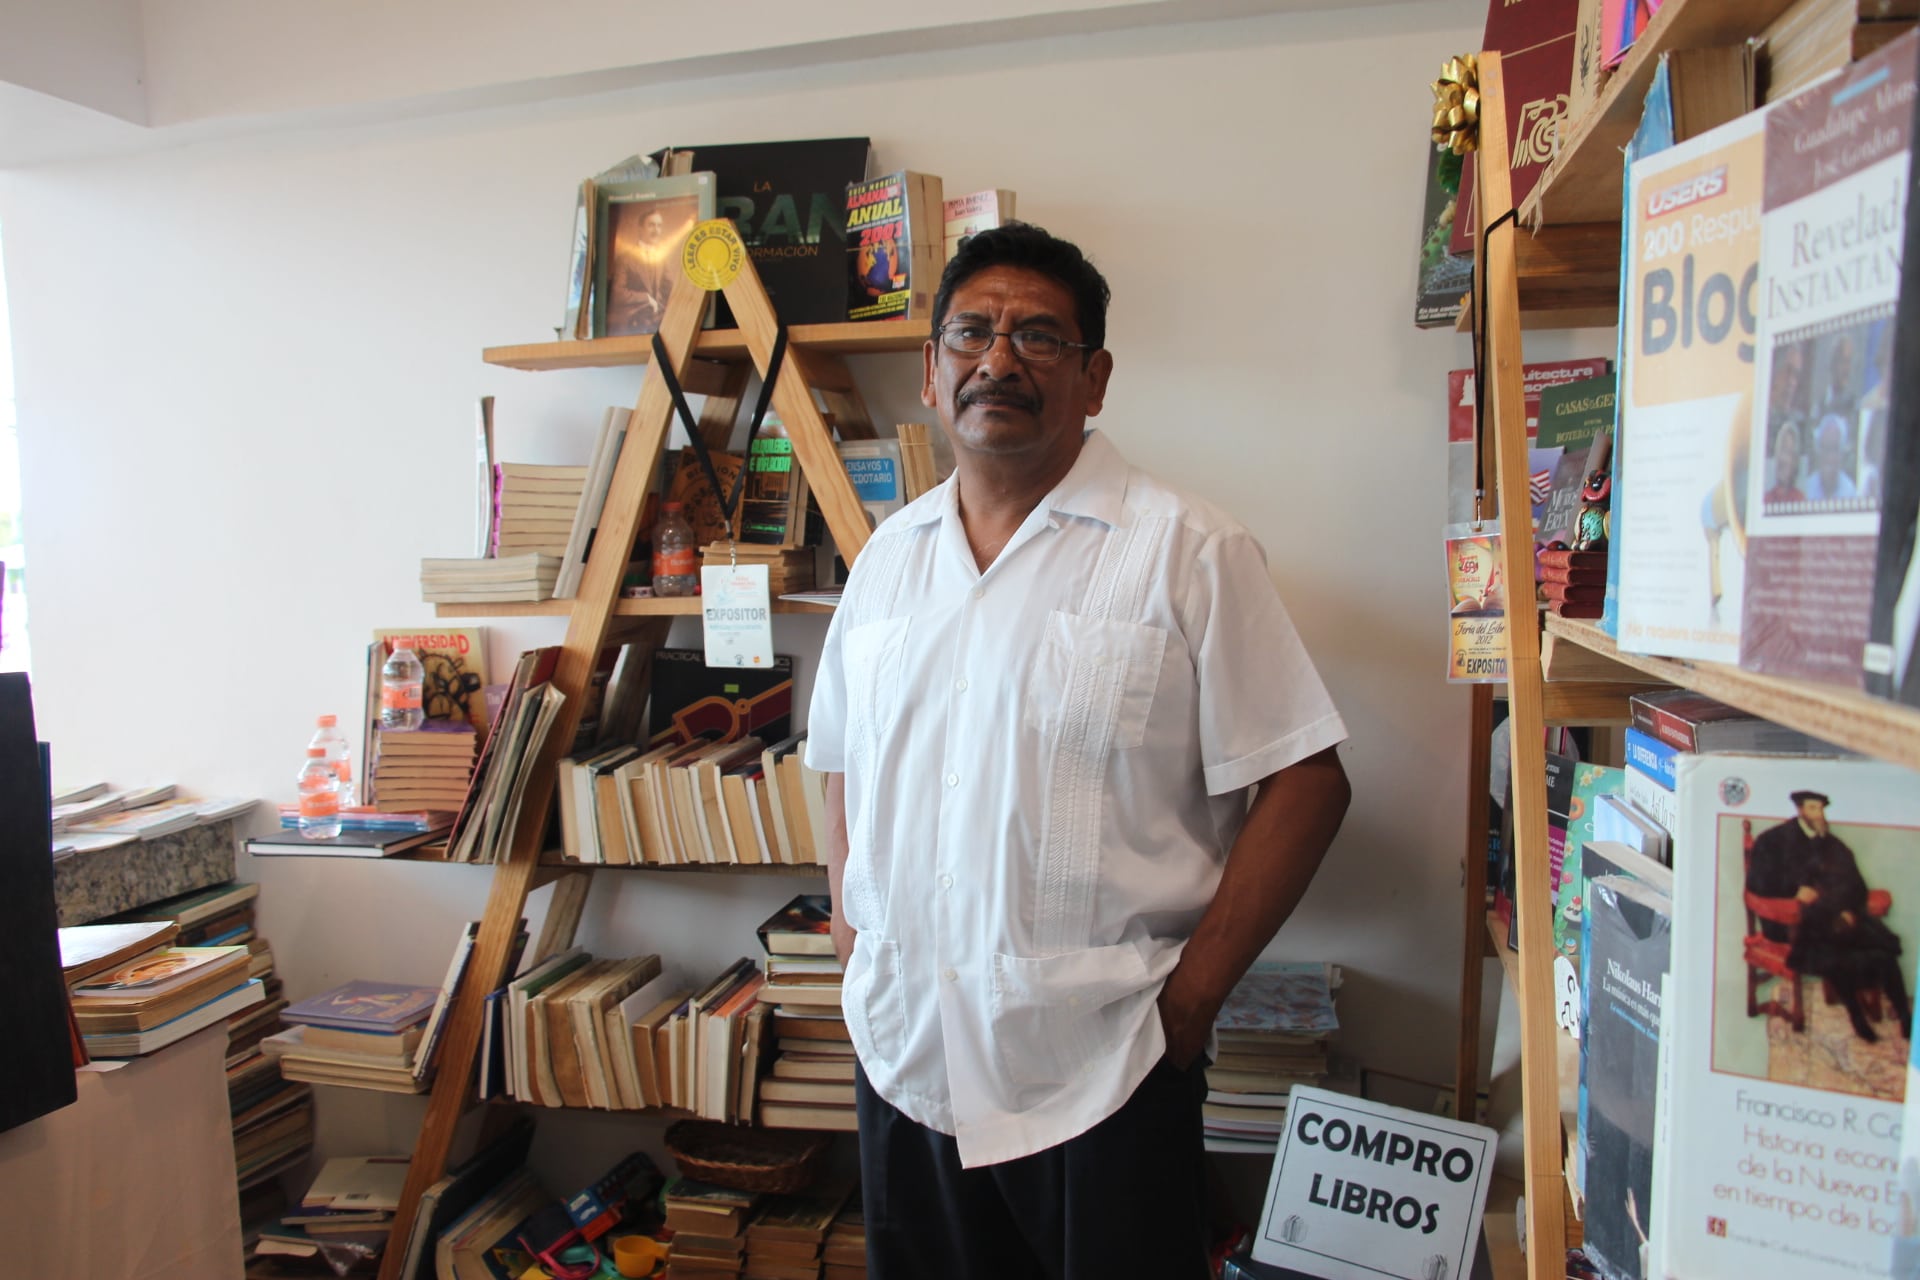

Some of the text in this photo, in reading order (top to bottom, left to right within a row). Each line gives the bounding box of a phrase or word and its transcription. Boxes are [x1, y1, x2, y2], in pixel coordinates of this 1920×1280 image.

[753, 181, 772, 192] LA
[847, 183, 901, 209] ALMANA
[1647, 168, 1725, 216] USERS
[715, 192, 848, 246] RAN
[847, 198, 902, 227] ANUAL
[860, 221, 903, 246] 2001
[1643, 220, 1684, 262] 200
[687, 226, 742, 272] LEER ES ESTAR VIVO
[748, 244, 818, 257] ORMACIÓN
[1642, 253, 1759, 362] Blog
[1523, 366, 1593, 386] uitectura
[848, 473, 892, 484] ECDOTARIO
[883, 460, 889, 471] Y
[706, 607, 767, 622] EXPOSITOR
[1475, 621, 1486, 634] del
[1486, 620, 1505, 635] Libr
[383, 633, 470, 655] UERSIDAD
[1475, 635, 1493, 645] 2012
[1467, 657, 1507, 674] EXPOSITO
[1602, 976, 1611, 993] La
[1606, 957, 1642, 994] Nikolaus
[1736, 1088, 1836, 1130] Francisco
[1842, 1106, 1864, 1134] R.
[1296, 1111, 1474, 1183] COMPRO
[1743, 1122, 1826, 1160] Historia
[1737, 1152, 1768, 1180] de
[1773, 1157, 1793, 1185] la
[1800, 1163, 1878, 1204] Nueva
[1307, 1173, 1441, 1235] LIBROS
[1712, 1182, 1741, 1203] en
[1744, 1185, 1823, 1223] tiempo
[1827, 1201, 1861, 1230] de
